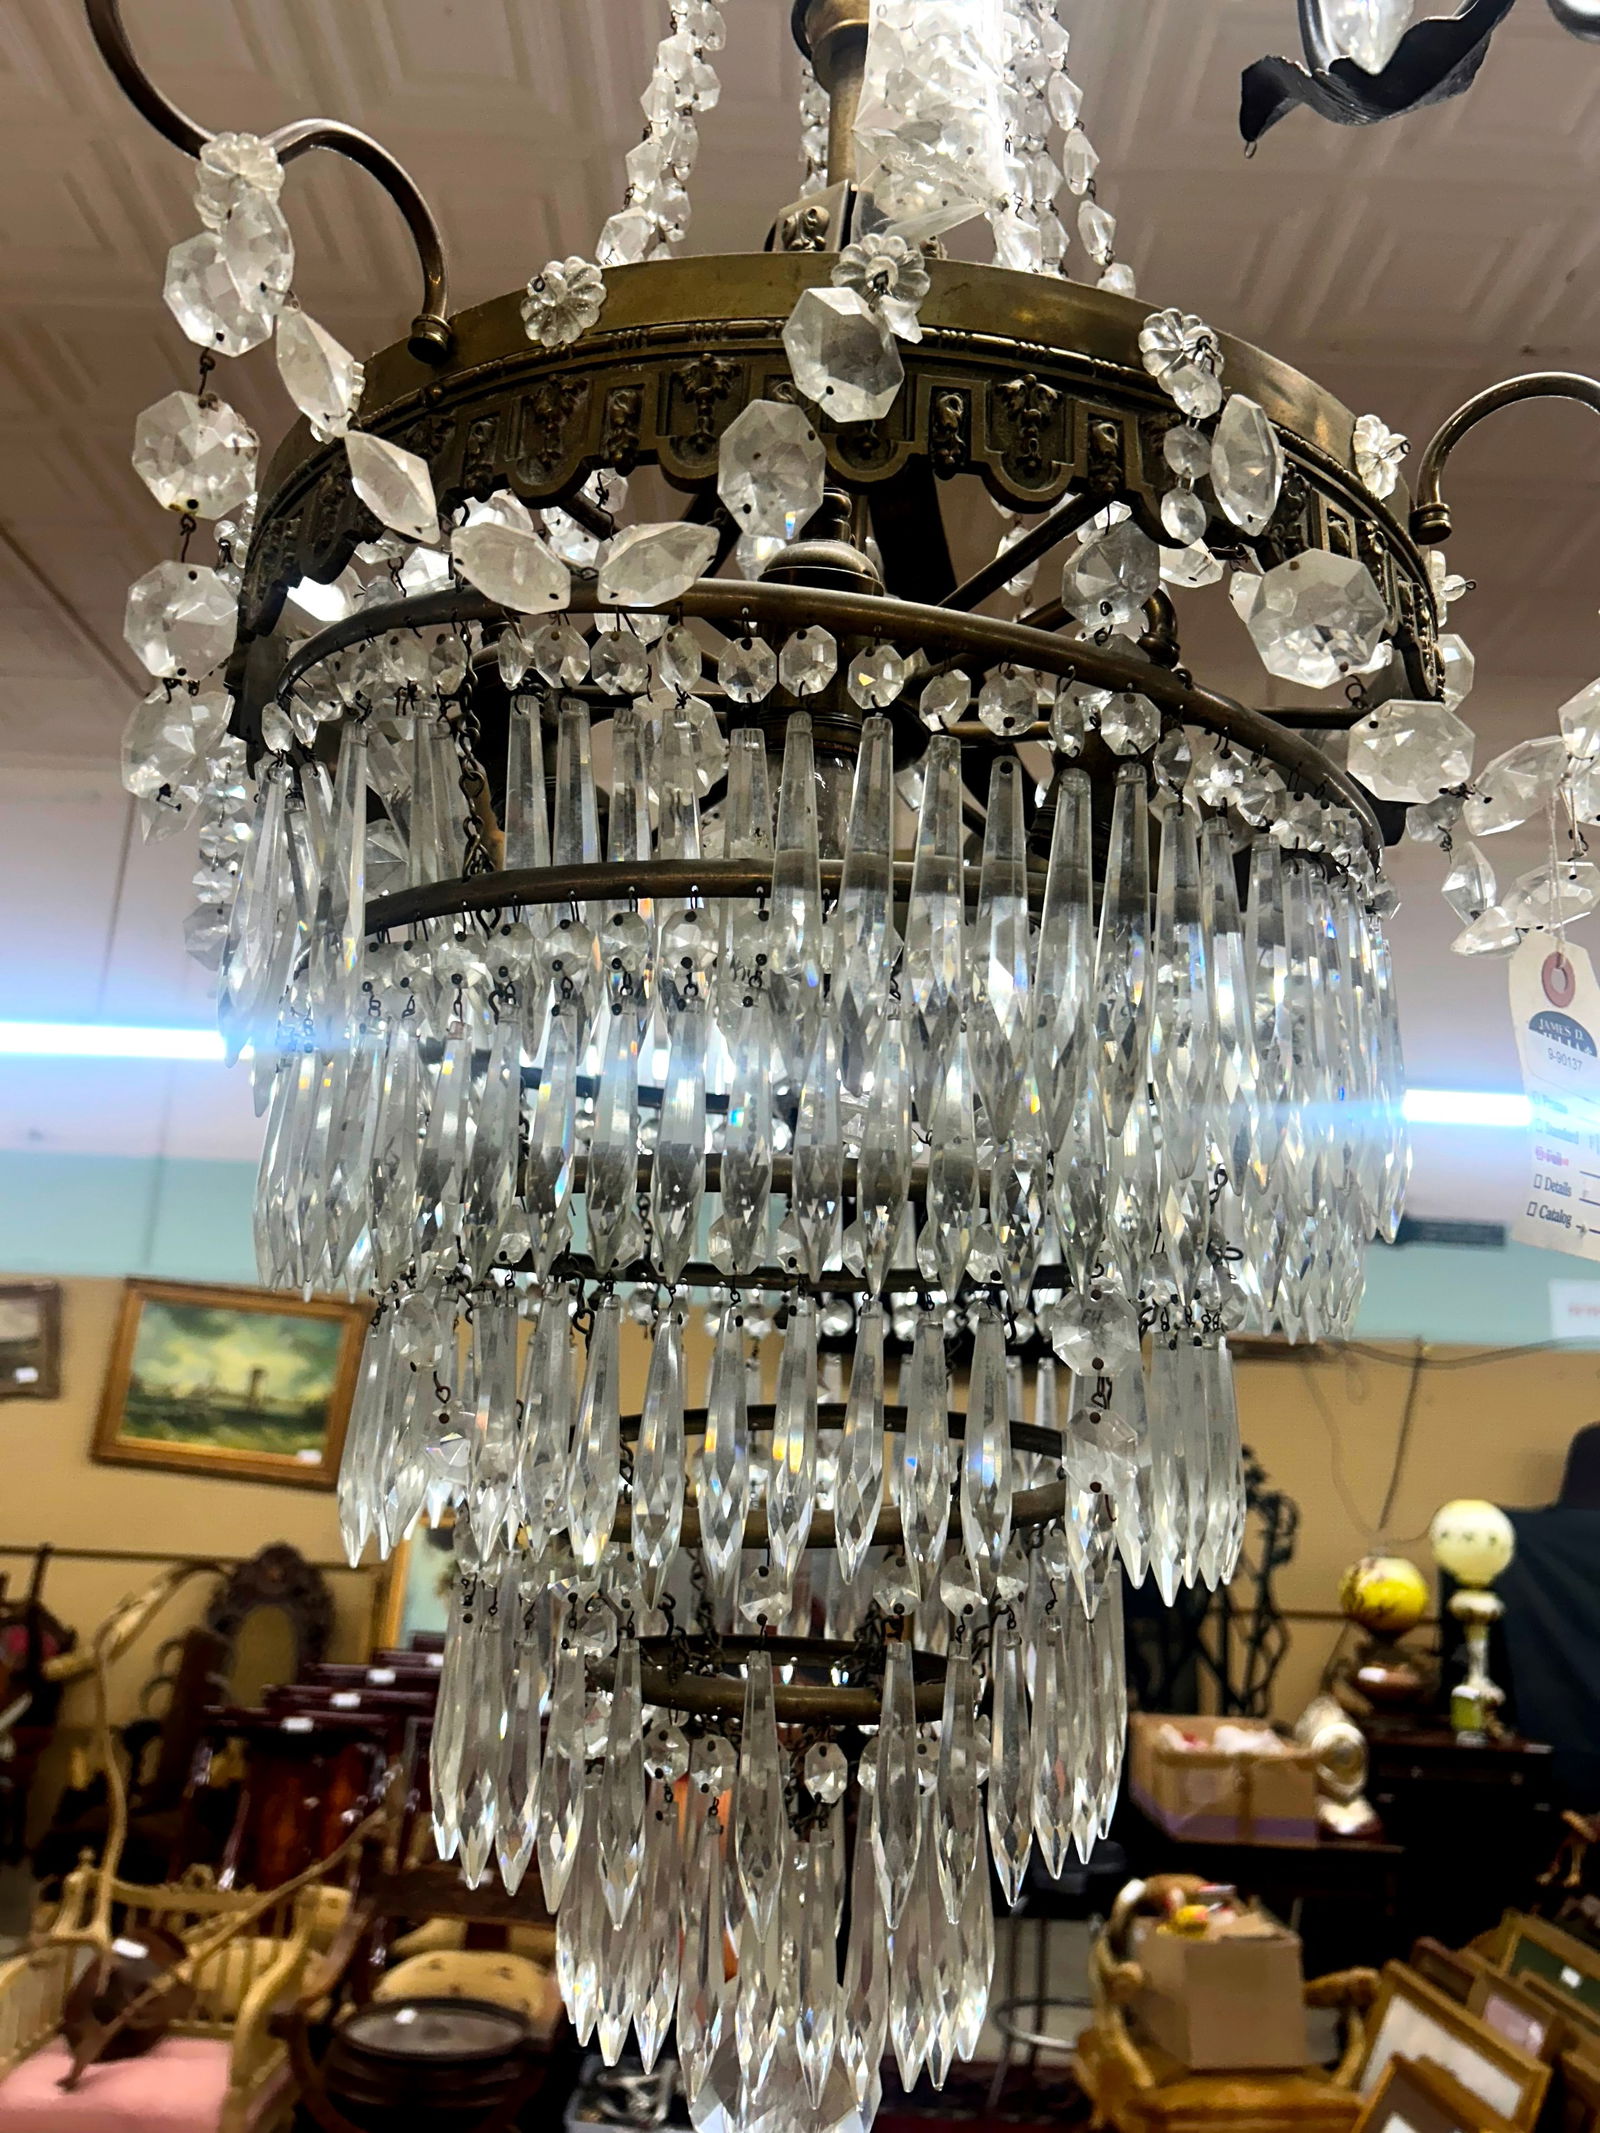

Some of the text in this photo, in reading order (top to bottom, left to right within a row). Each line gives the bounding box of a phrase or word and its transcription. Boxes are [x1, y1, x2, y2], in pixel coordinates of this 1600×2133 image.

[1538, 1018, 1571, 1038] JAMES
[1547, 1047, 1583, 1072] 9-90137
[1544, 1176, 1572, 1197] Details
[1539, 1204, 1572, 1229] Catalog
